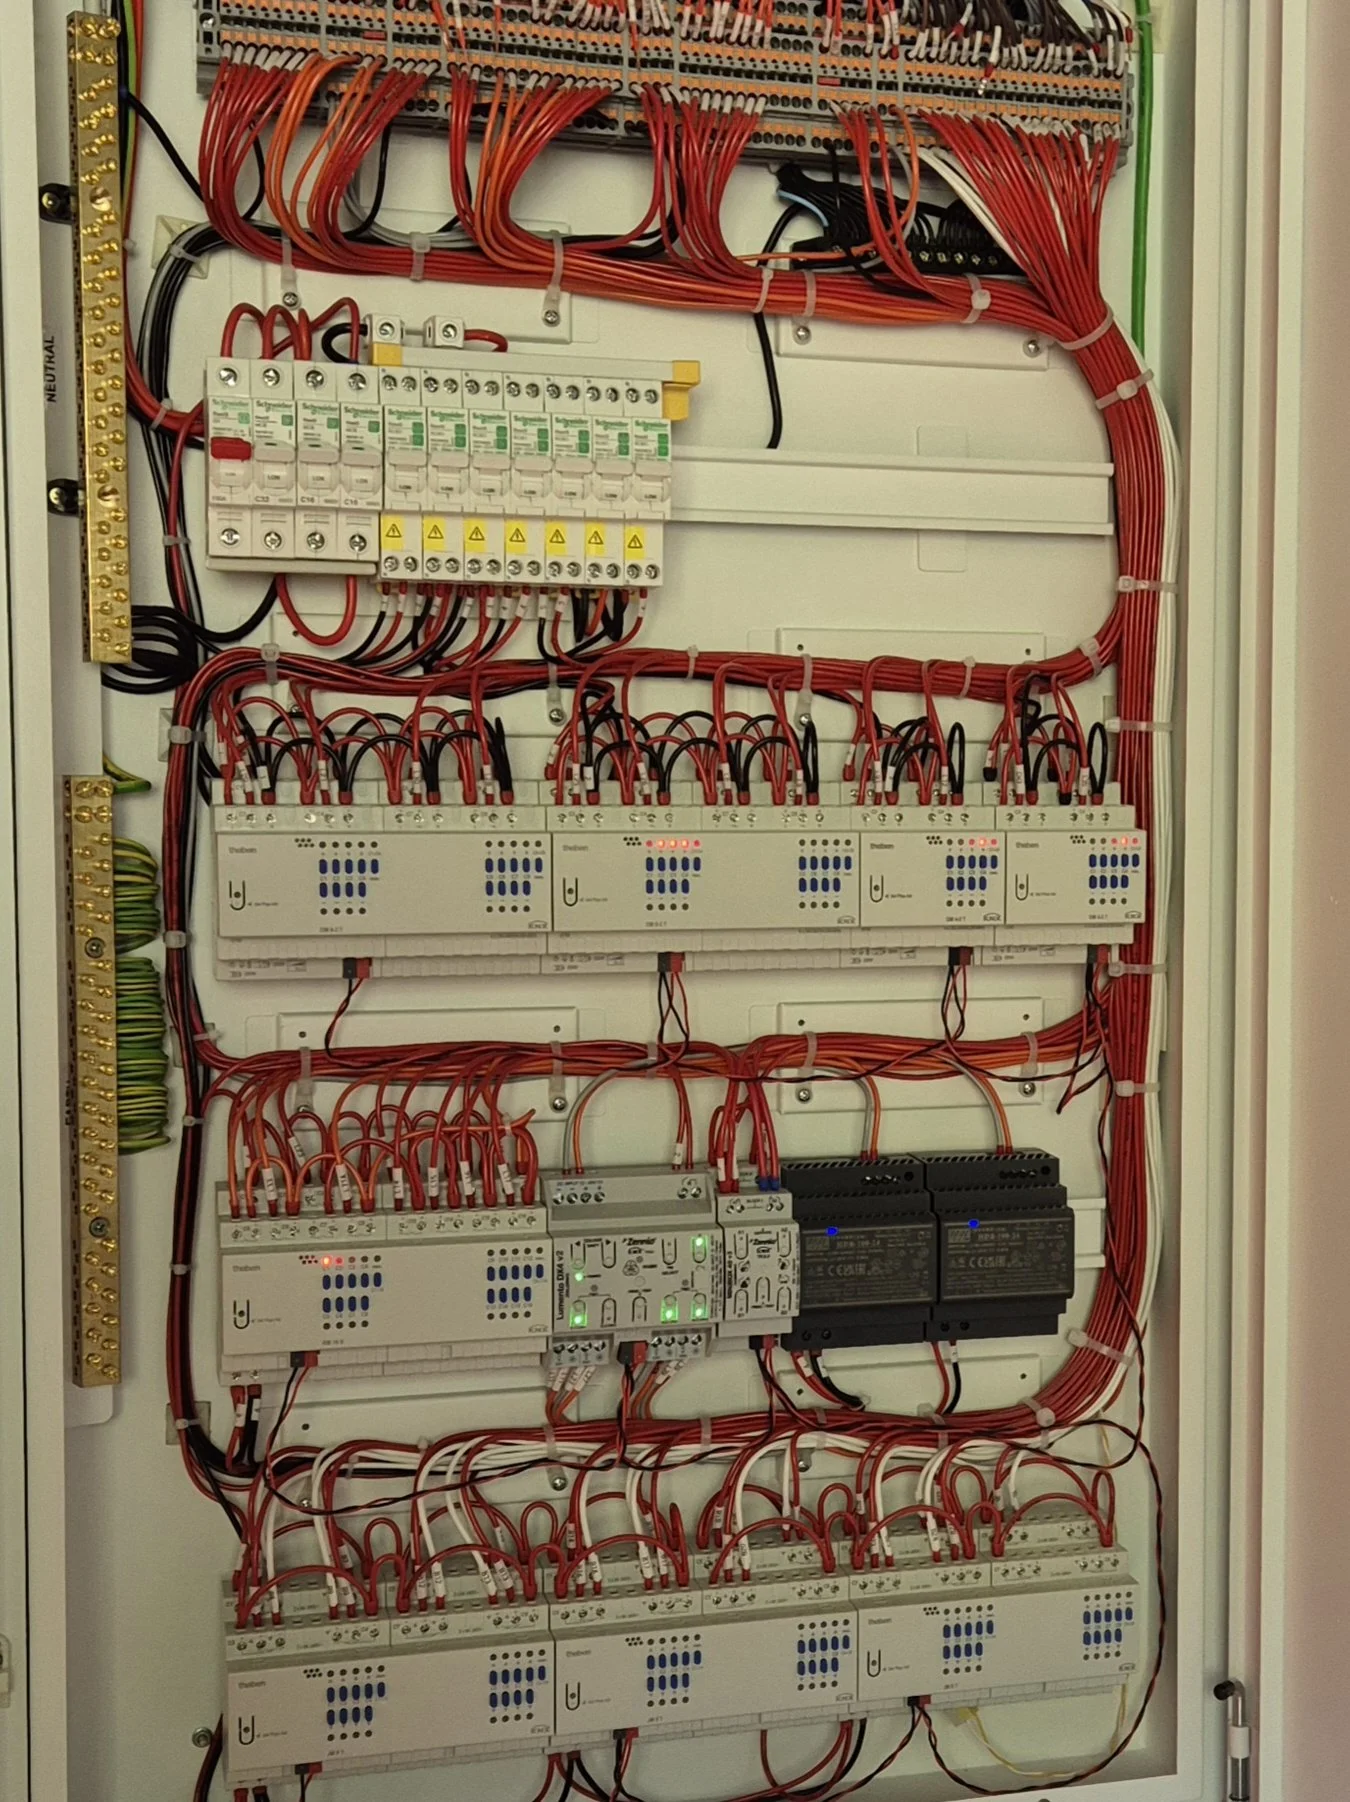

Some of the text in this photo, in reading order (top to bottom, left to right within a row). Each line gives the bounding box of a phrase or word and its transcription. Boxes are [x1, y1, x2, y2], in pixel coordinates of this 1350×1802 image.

[43, 336, 57, 403] NEUTRAL
[627, 1237, 656, 1246] Zennio
[556, 1250, 564, 1320] Lumento DX4 v2
